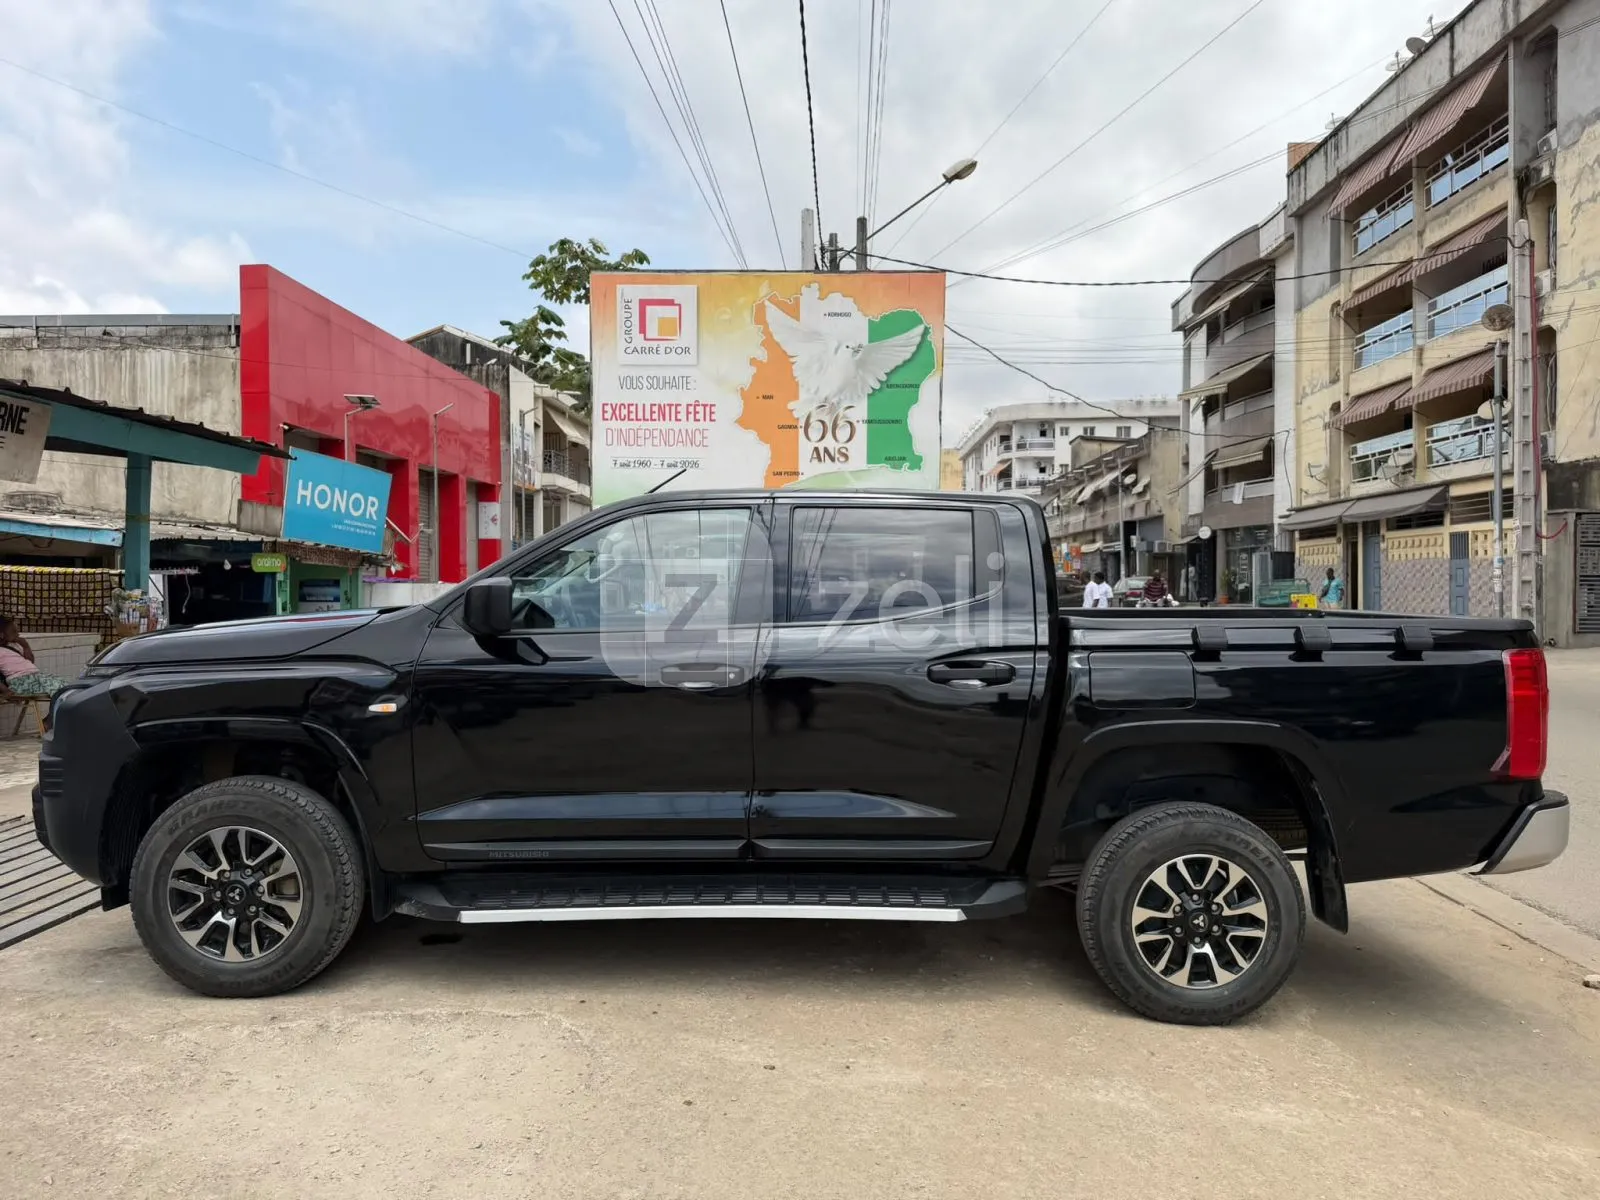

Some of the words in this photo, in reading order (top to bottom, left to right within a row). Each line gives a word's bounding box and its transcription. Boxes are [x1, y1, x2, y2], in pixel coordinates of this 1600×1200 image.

[624, 298, 633, 344] GROUPE
[624, 344, 660, 355] CARRÉ
[664, 346, 691, 355] D'OR
[618, 375, 644, 390] VOUS
[646, 375, 691, 390] SOUHAITE
[601, 402, 682, 422] EXCELLENTE
[686, 400, 717, 422] FÊTE
[803, 404, 857, 444] 66
[605, 425, 710, 447] D'INDÉPENDANCE
[633, 459, 652, 468] 1960
[809, 446, 850, 464] ANS
[296, 479, 379, 521] HONOR
